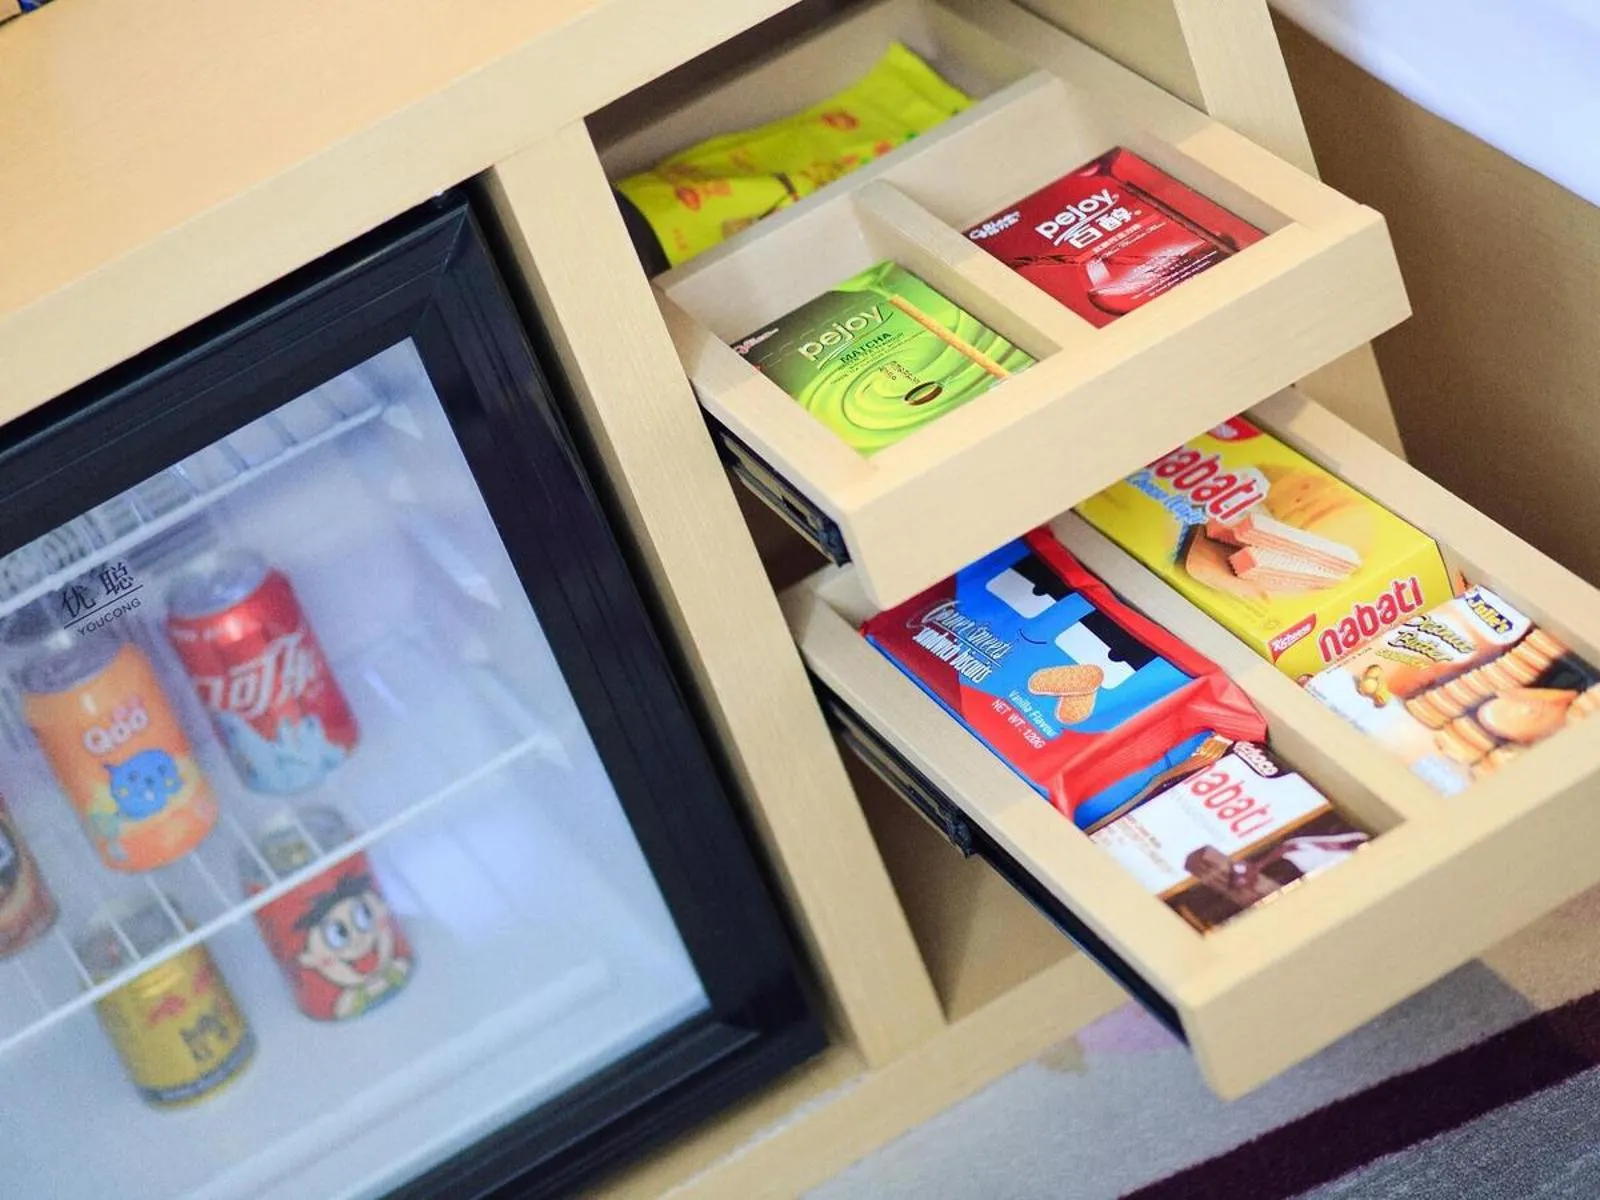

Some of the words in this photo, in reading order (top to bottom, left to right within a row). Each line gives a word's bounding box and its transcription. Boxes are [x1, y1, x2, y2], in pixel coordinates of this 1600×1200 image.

[1035, 188, 1113, 240] pejoy
[798, 304, 884, 361] pejoy
[840, 331, 893, 364] MATCHA
[1146, 447, 1263, 520] abati
[62, 562, 134, 618] 优聪
[77, 598, 142, 637] YOUCONG
[1320, 577, 1423, 662] nabati
[949, 646, 993, 683] biscuits
[991, 699, 1012, 716] NET
